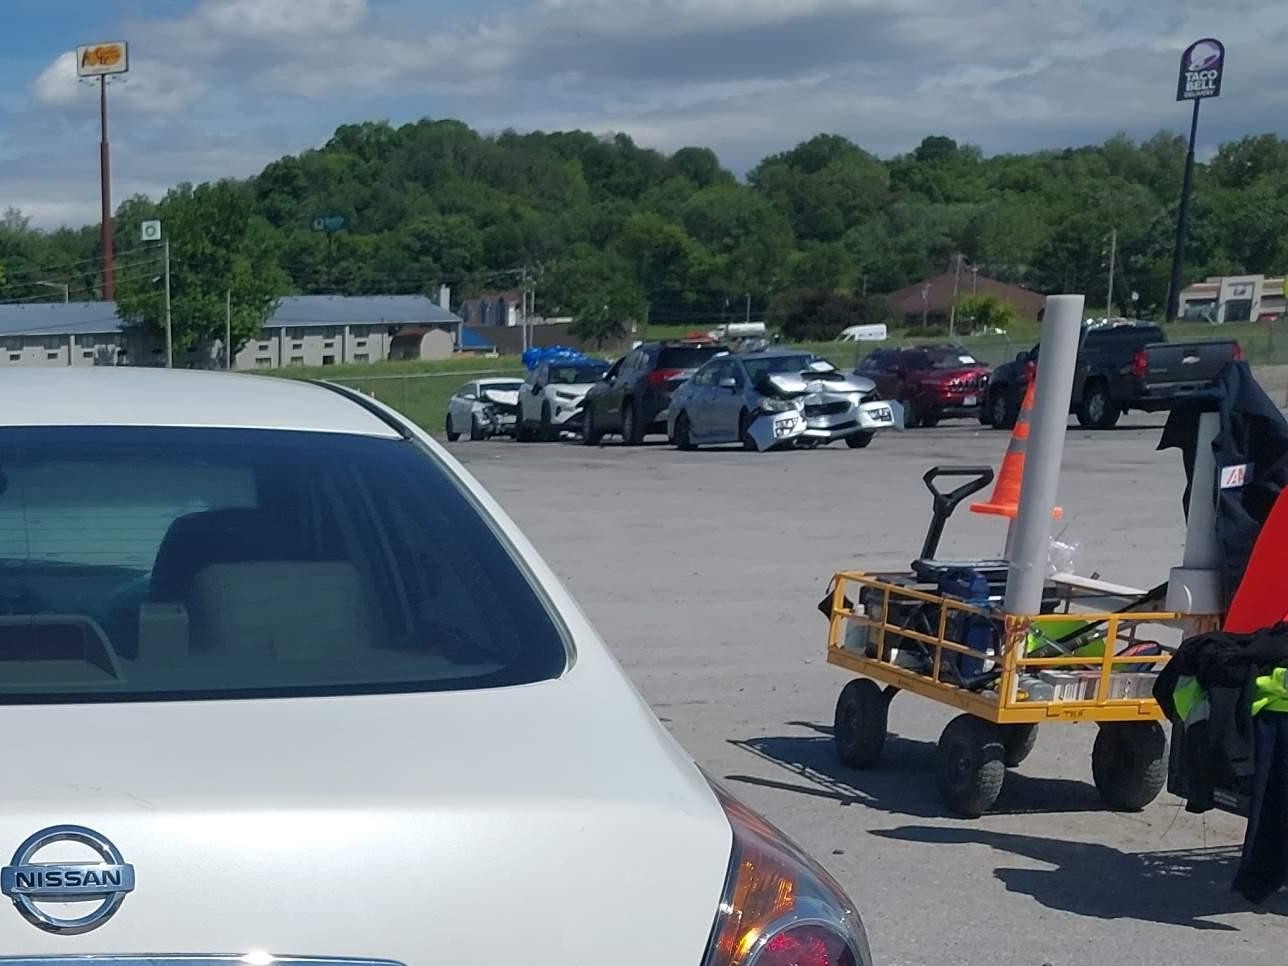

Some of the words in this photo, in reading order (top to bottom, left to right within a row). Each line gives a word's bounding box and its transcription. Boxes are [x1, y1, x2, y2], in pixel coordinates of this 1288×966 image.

[1184, 69, 1218, 81] TACO
[1185, 79, 1216, 92] BELL
[16, 870, 121, 887] NISSAN
